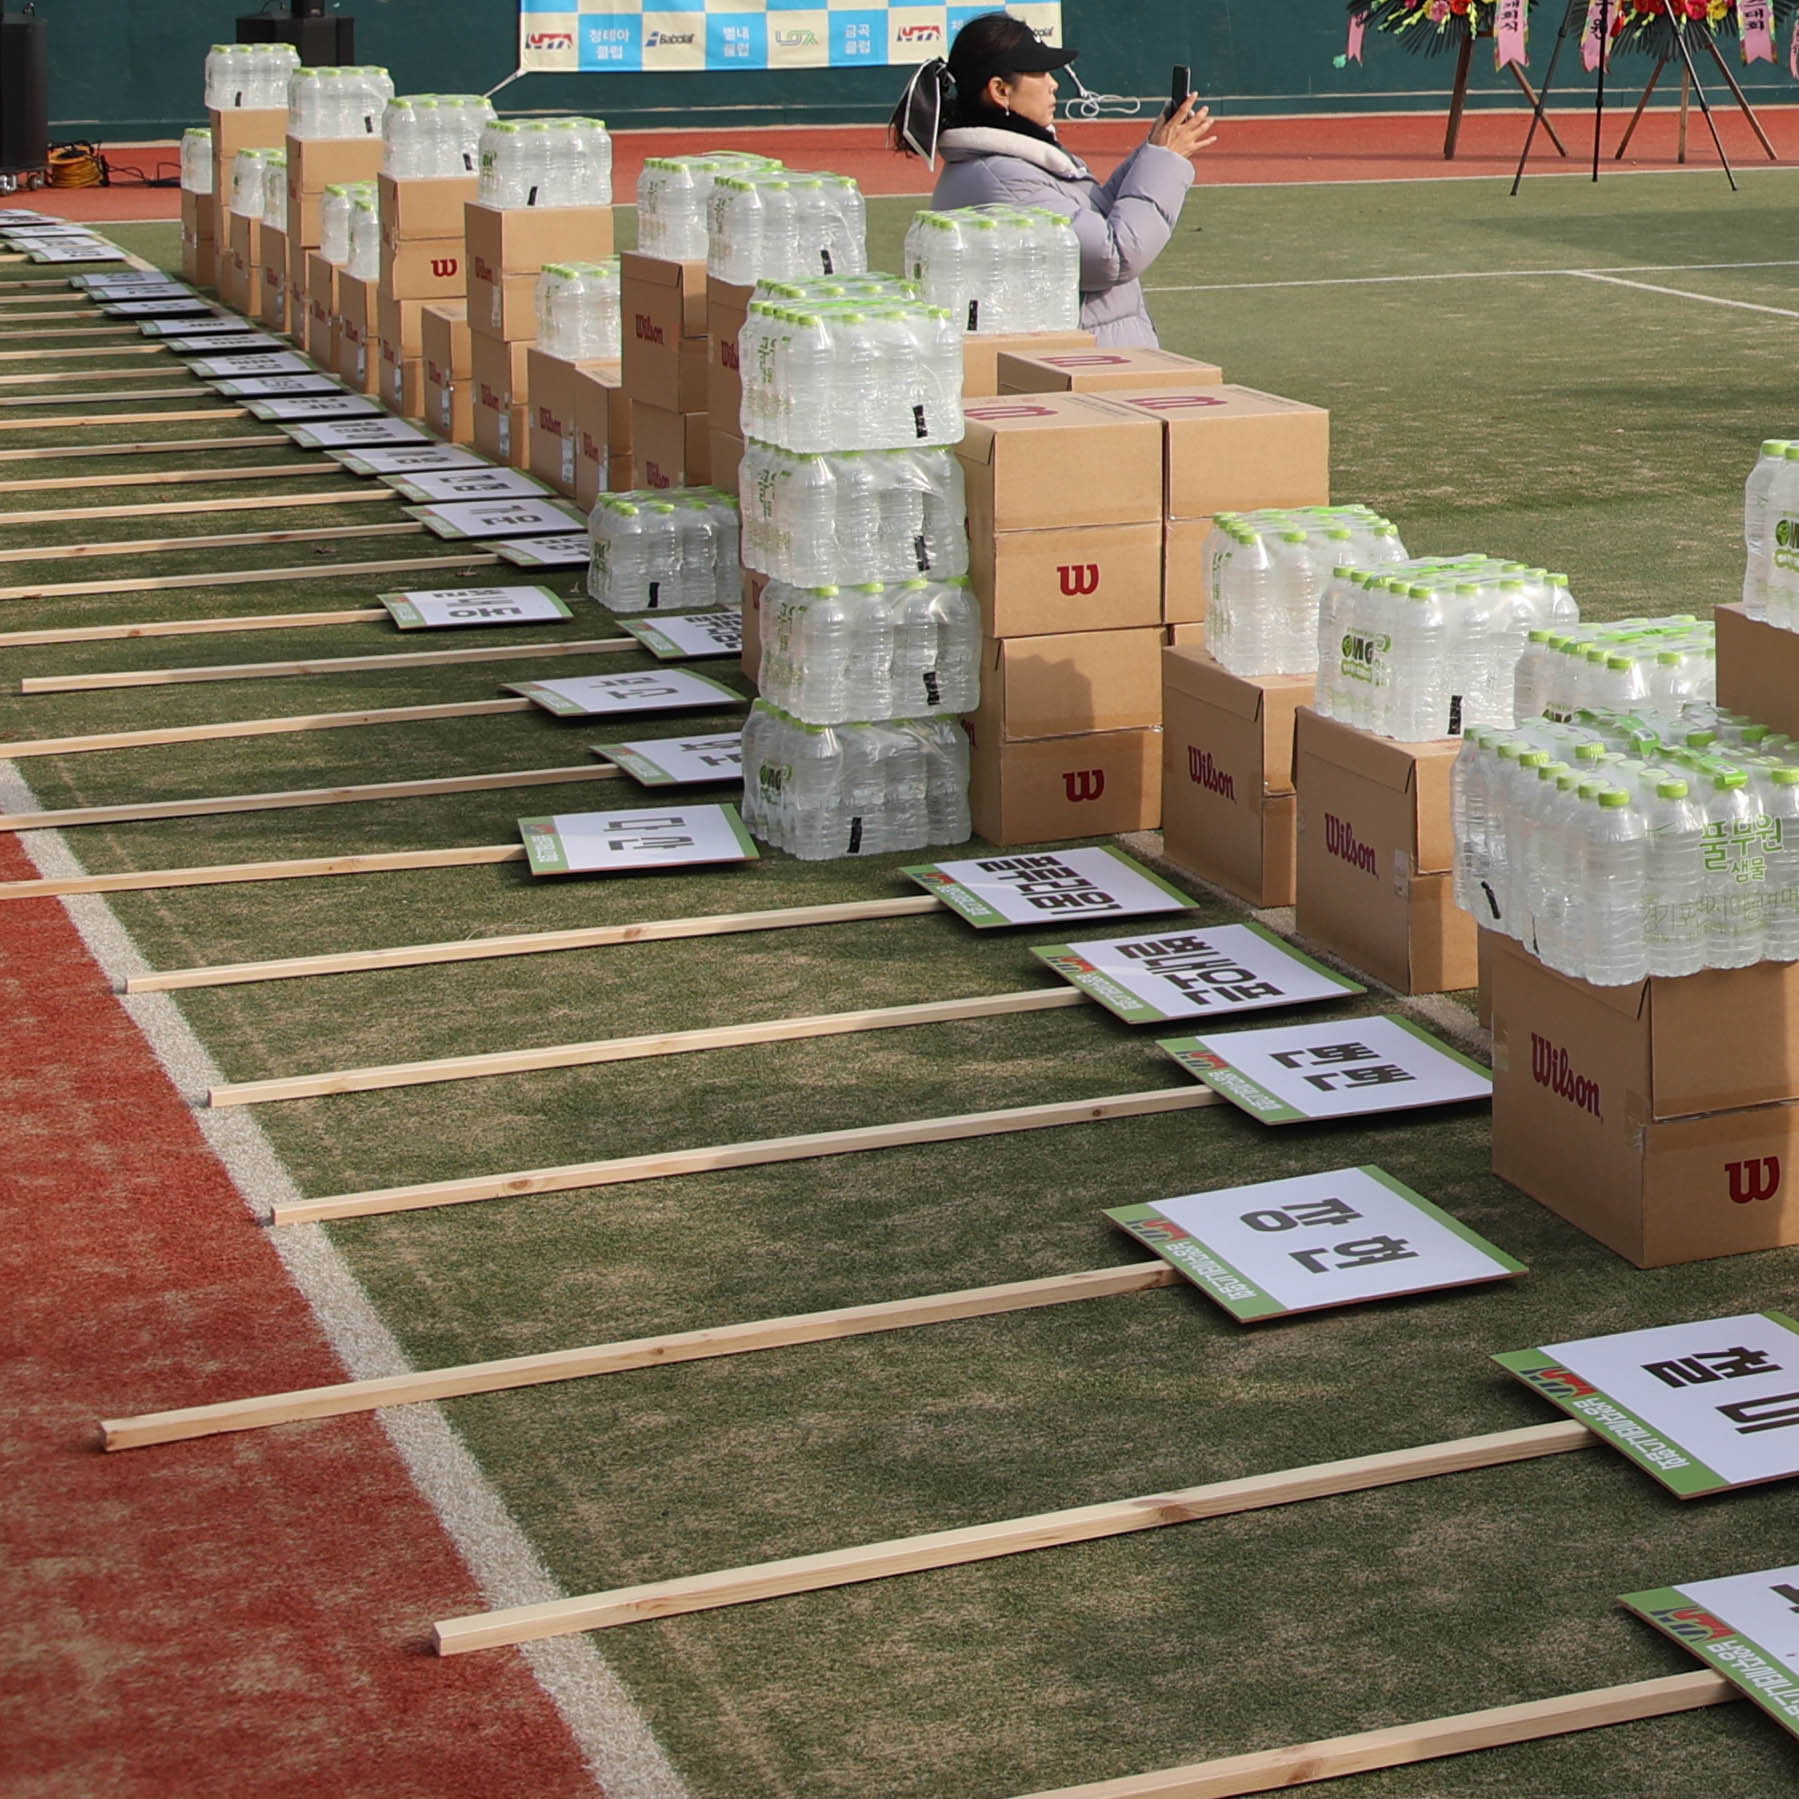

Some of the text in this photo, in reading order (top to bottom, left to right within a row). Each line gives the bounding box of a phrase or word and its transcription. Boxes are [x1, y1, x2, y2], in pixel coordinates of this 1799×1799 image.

[634, 312, 664, 346] Wilson
[1187, 743, 1236, 801] Wilson
[602, 816, 696, 852] 다산
[1324, 811, 1378, 878] Wilson
[1699, 814, 1783, 873] 풀무원
[1730, 856, 1767, 885] 샘물
[1113, 935, 1286, 1005] 별내오픈
[1529, 1030, 1601, 1119] Wilson
[1238, 1196, 1421, 1274] 장현
[1164, 1240, 1259, 1301] 남양주시테니스협회
[1572, 1397, 1691, 1472] 남양주시테니스협회
